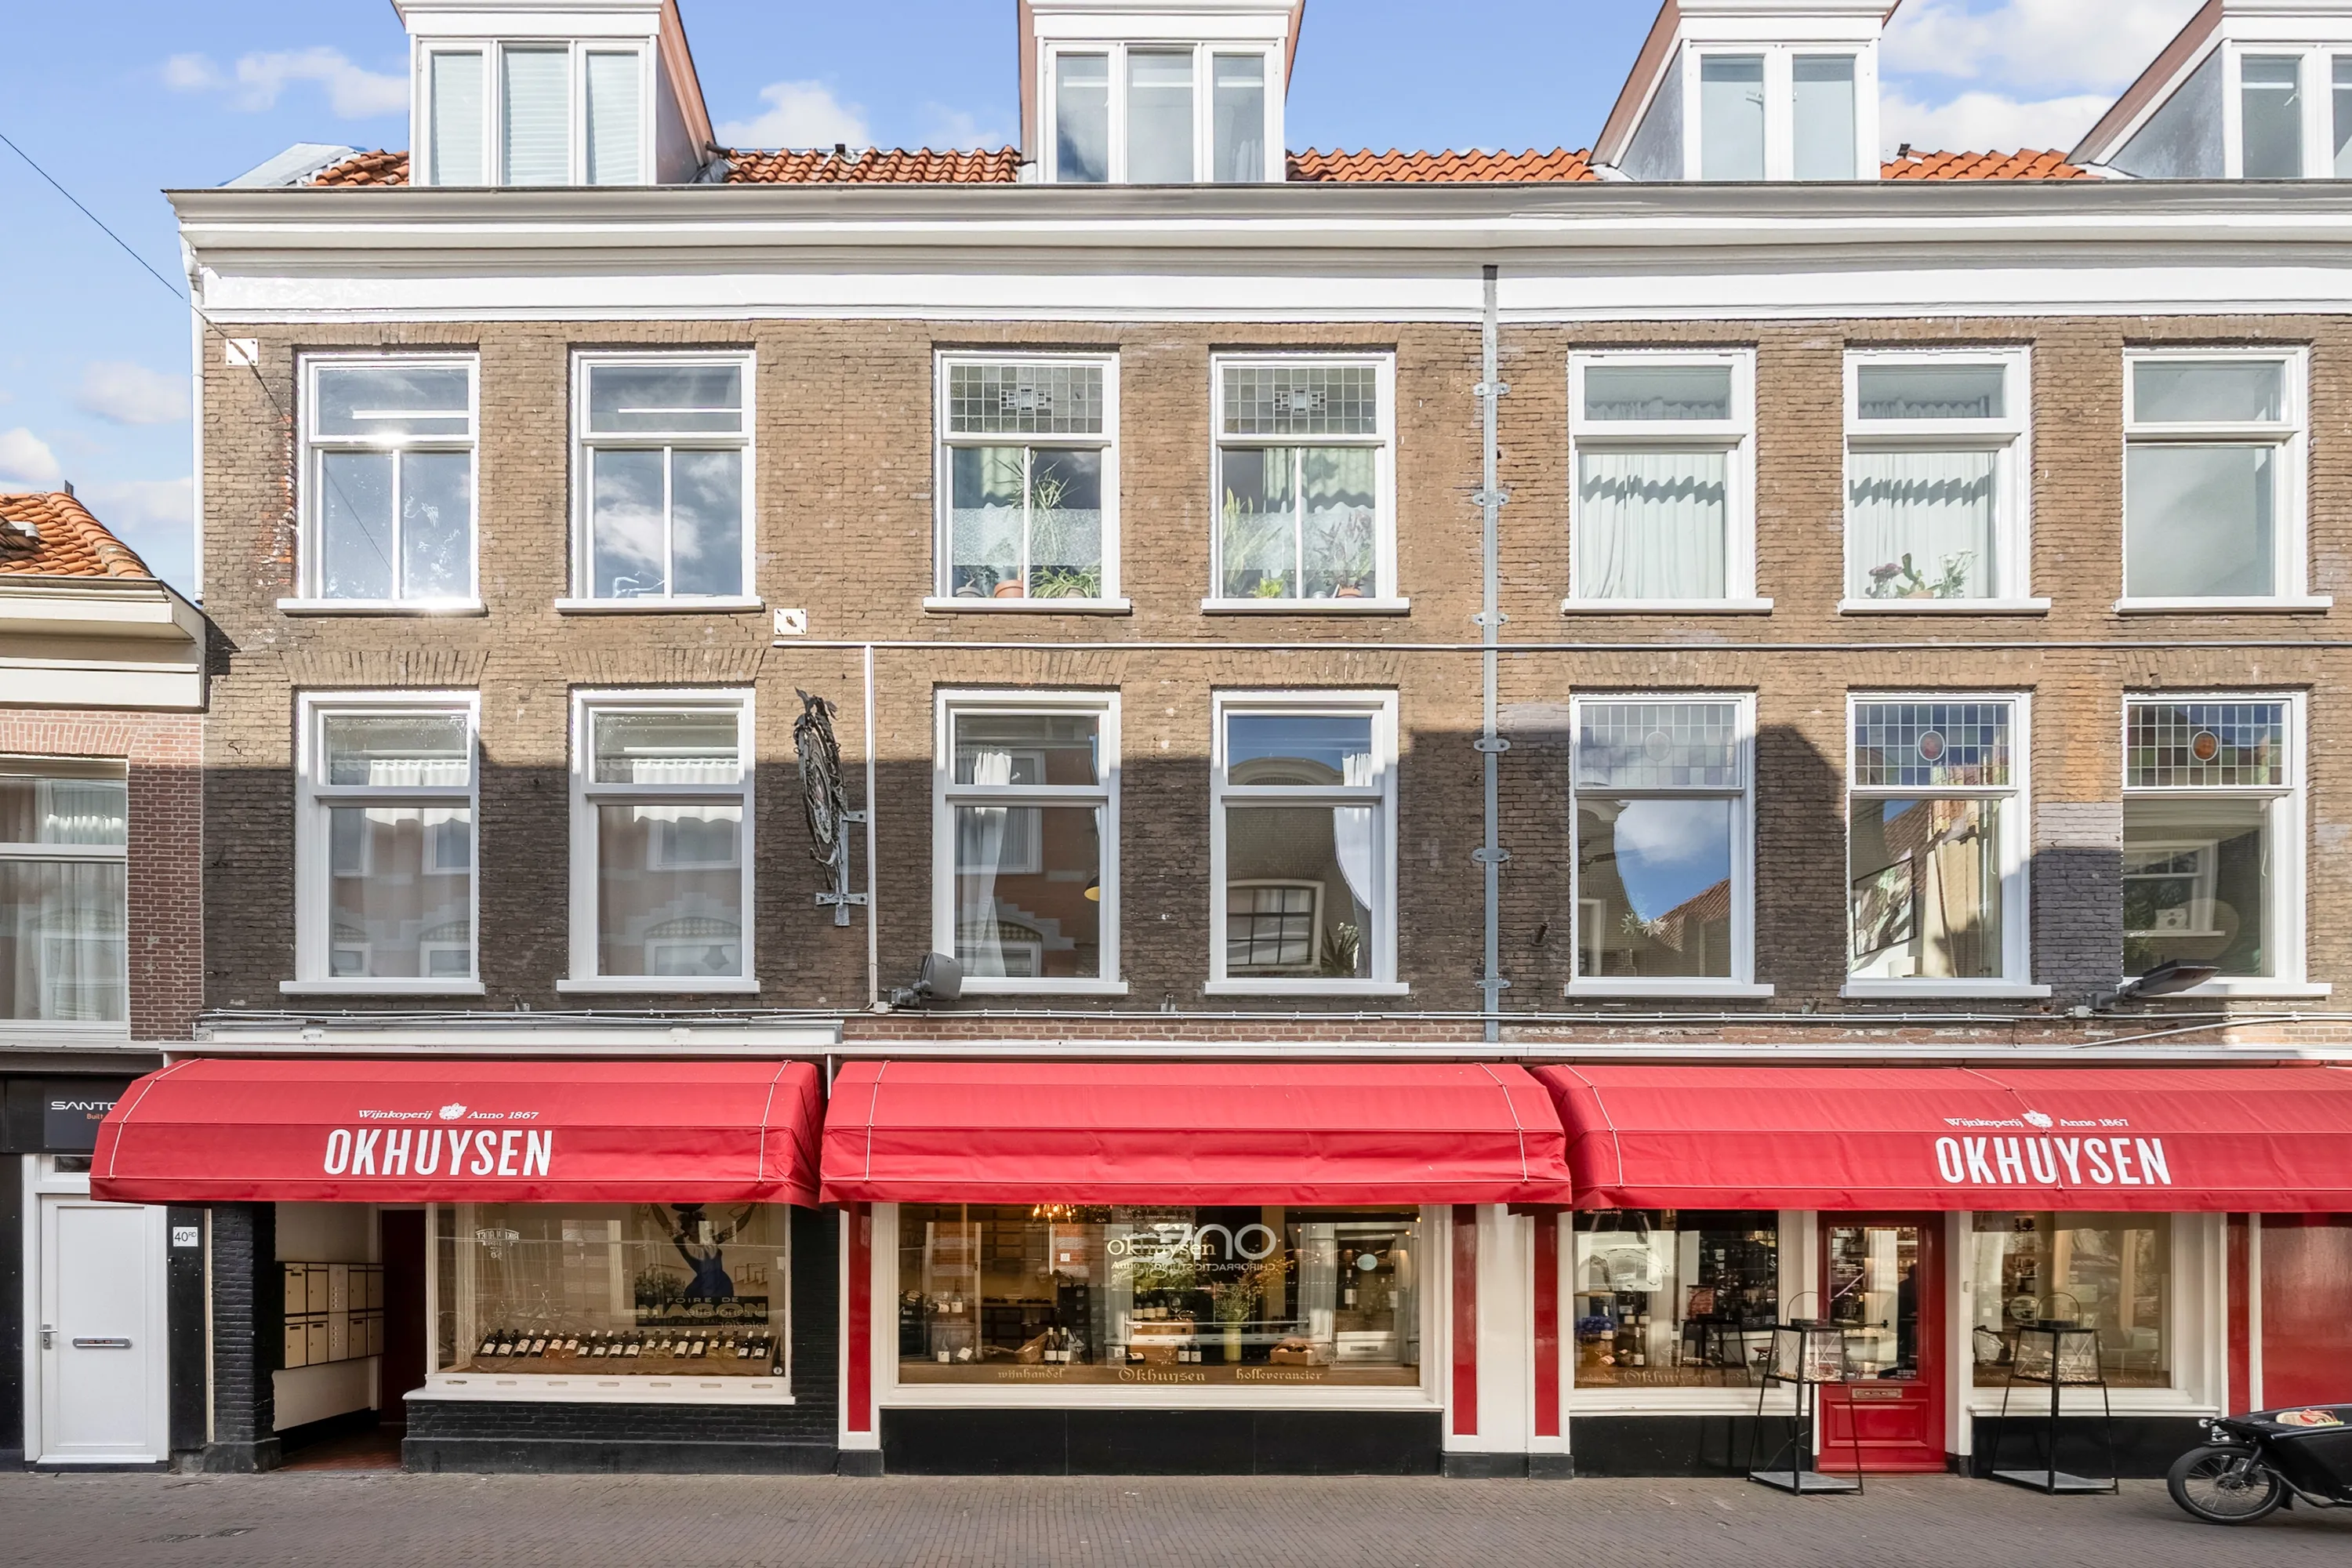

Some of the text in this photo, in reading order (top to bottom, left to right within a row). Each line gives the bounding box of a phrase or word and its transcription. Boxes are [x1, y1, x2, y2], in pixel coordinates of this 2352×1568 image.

[358, 1109, 539, 1120] Wijnkoperij Anno 1867
[1944, 1117, 2129, 1128] Wijnkoperij Anno 1867
[324, 1128, 553, 1176] OKHUYSEN
[1934, 1136, 2172, 1185] OKHUYSEN
[1107, 1238, 1216, 1259] Okhuysen
[1110, 1261, 1140, 1269] Anno
[998, 1367, 1065, 1379] wijnhandel
[1119, 1367, 1206, 1383] Okhuysen
